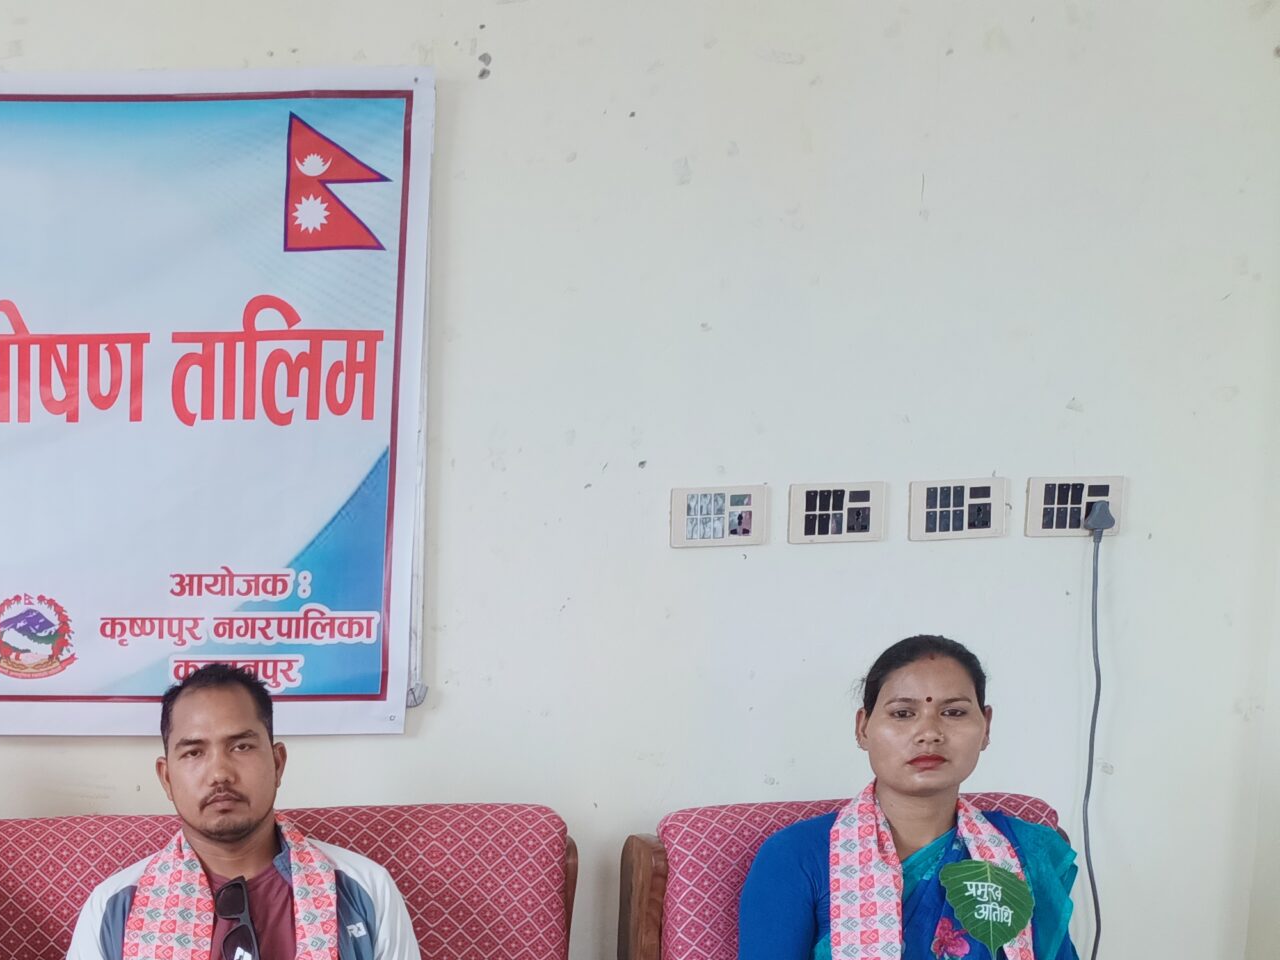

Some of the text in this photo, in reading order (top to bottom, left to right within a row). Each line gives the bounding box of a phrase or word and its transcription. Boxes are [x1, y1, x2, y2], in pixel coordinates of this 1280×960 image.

[172, 294, 383, 428] तालिम
[170, 566, 291, 597] आयोजक
[99, 608, 375, 647] कृष्णपुर नगरपालिका
[963, 881, 1003, 902] प्रमुख
[974, 903, 1014, 927] अतिथि
